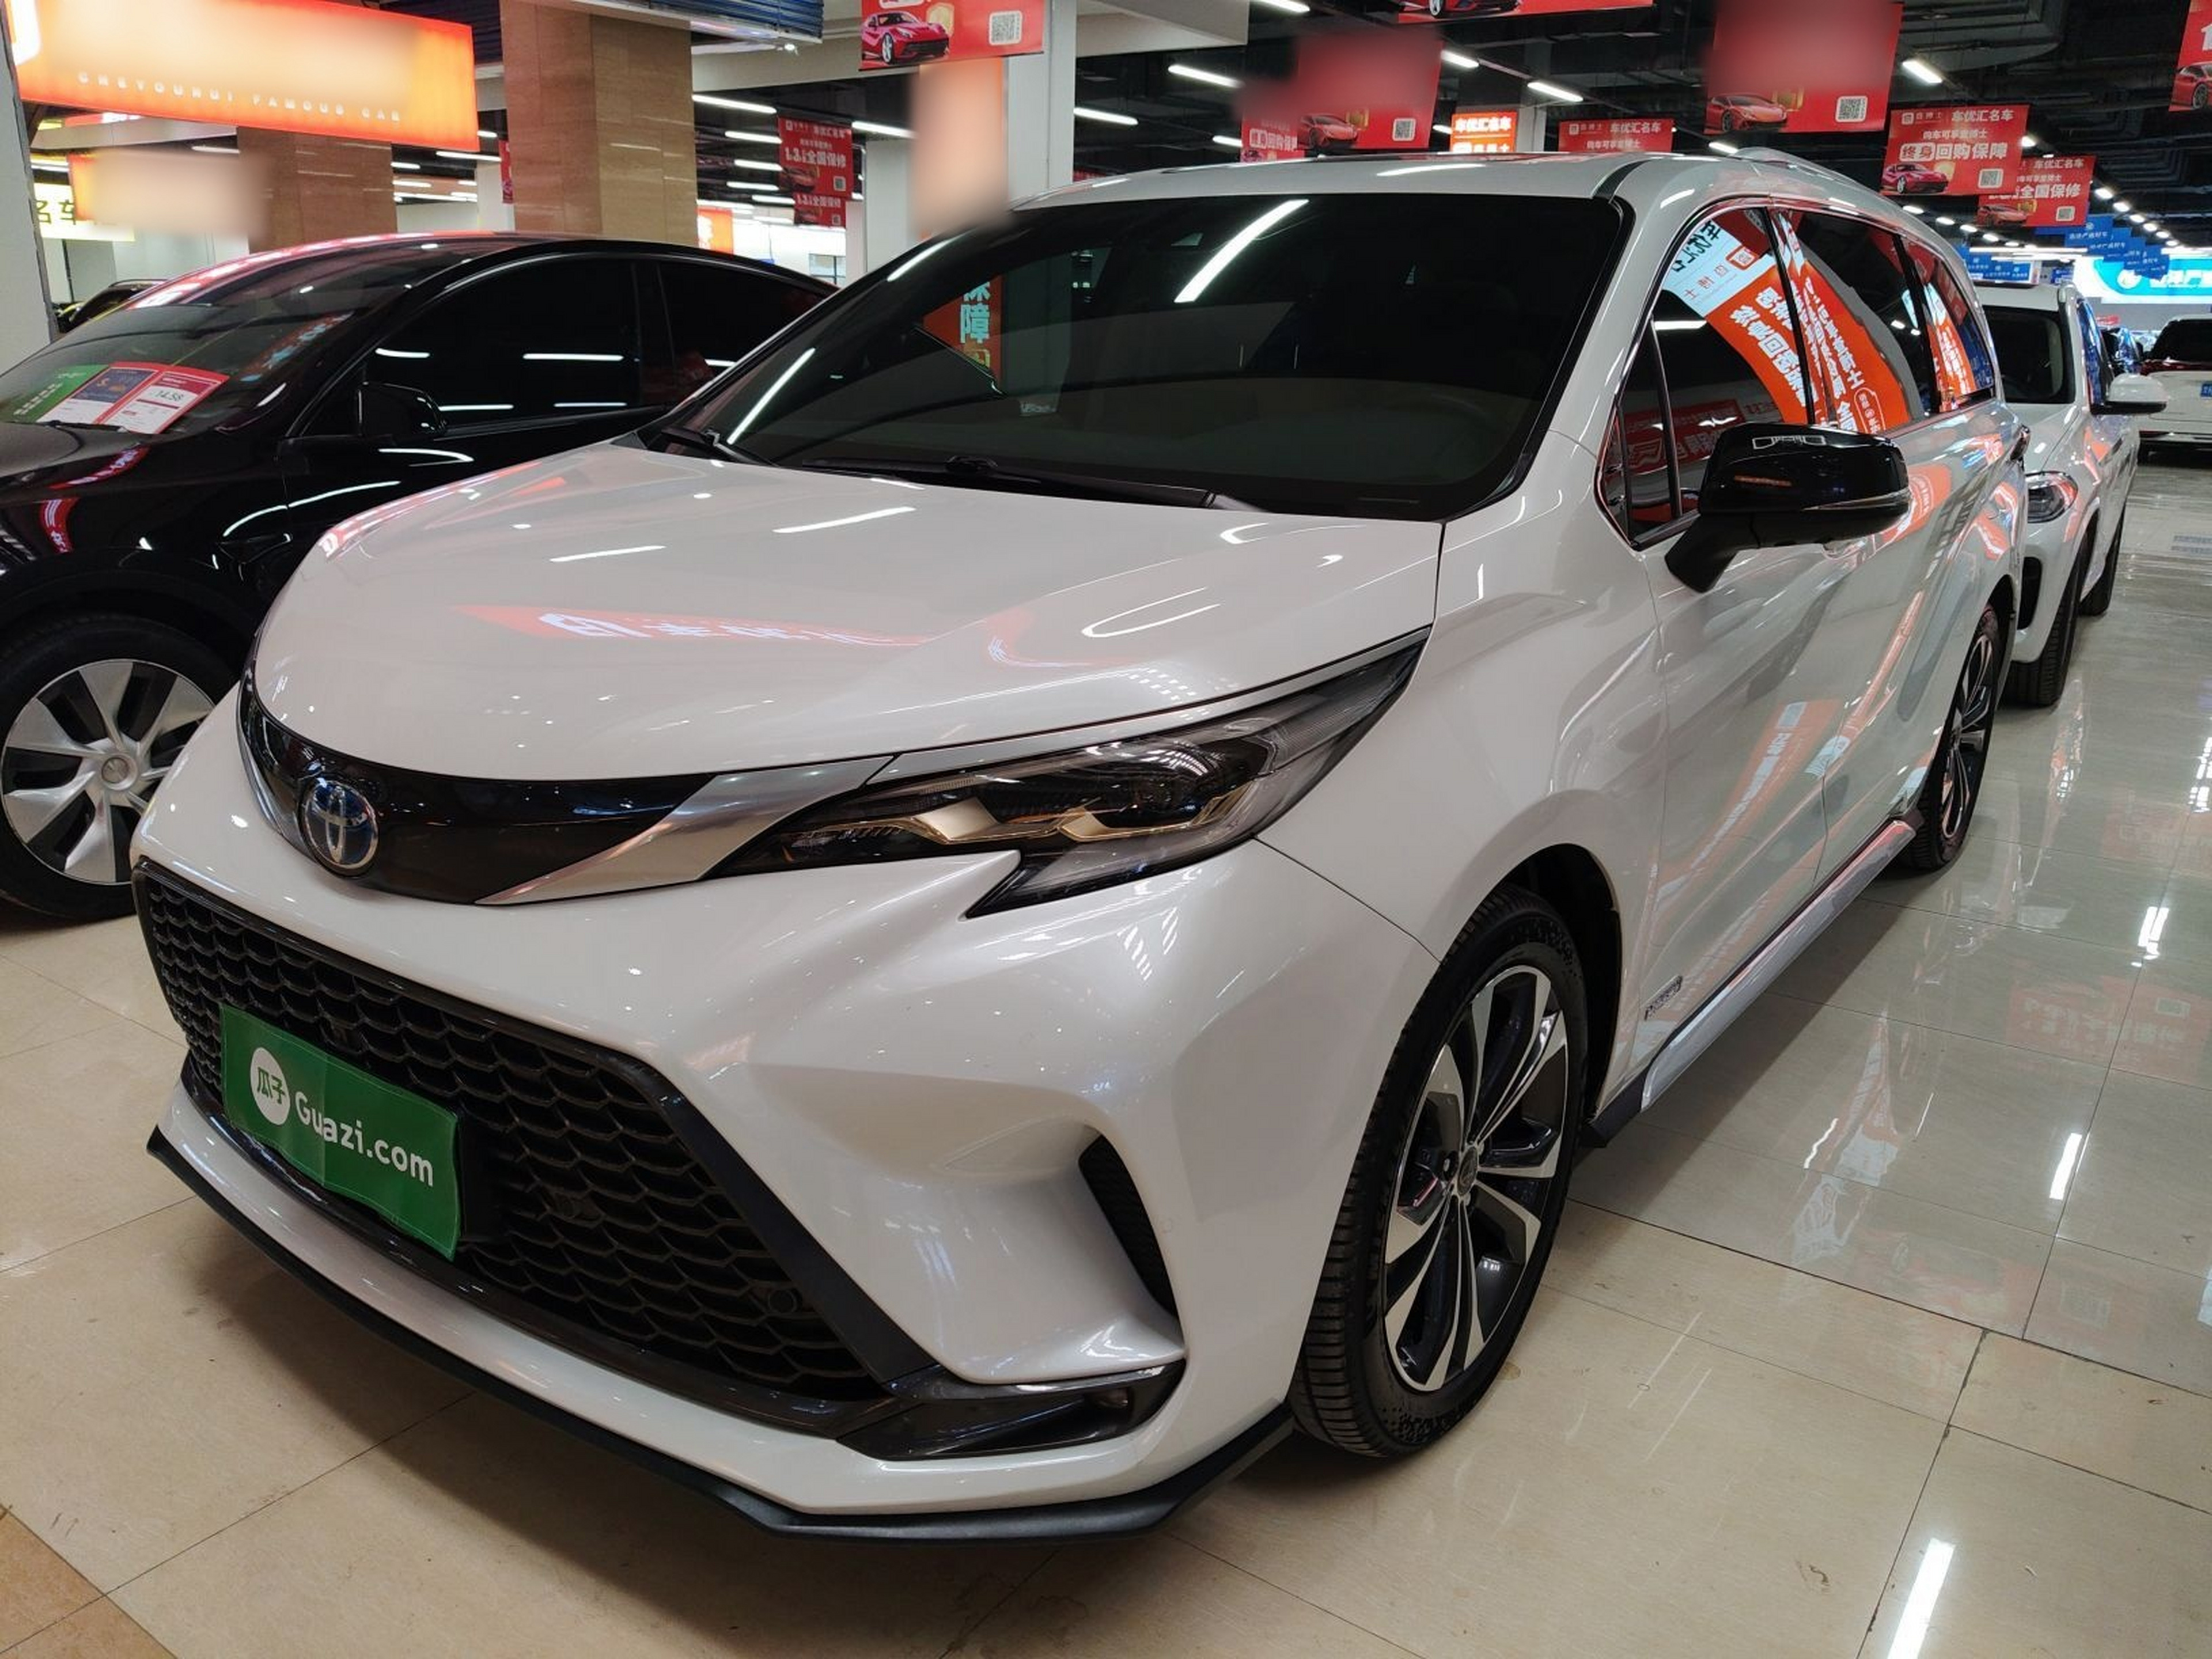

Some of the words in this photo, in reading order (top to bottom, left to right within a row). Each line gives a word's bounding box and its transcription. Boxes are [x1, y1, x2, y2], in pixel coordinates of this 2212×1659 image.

[252, 93, 346, 116] FAMOUS
[1952, 109, 2014, 122] 车优汇名车
[1900, 142, 2009, 161] 终身回购保障
[257, 1067, 286, 1105] 瓜子
[295, 1090, 434, 1188] Guazi.com
